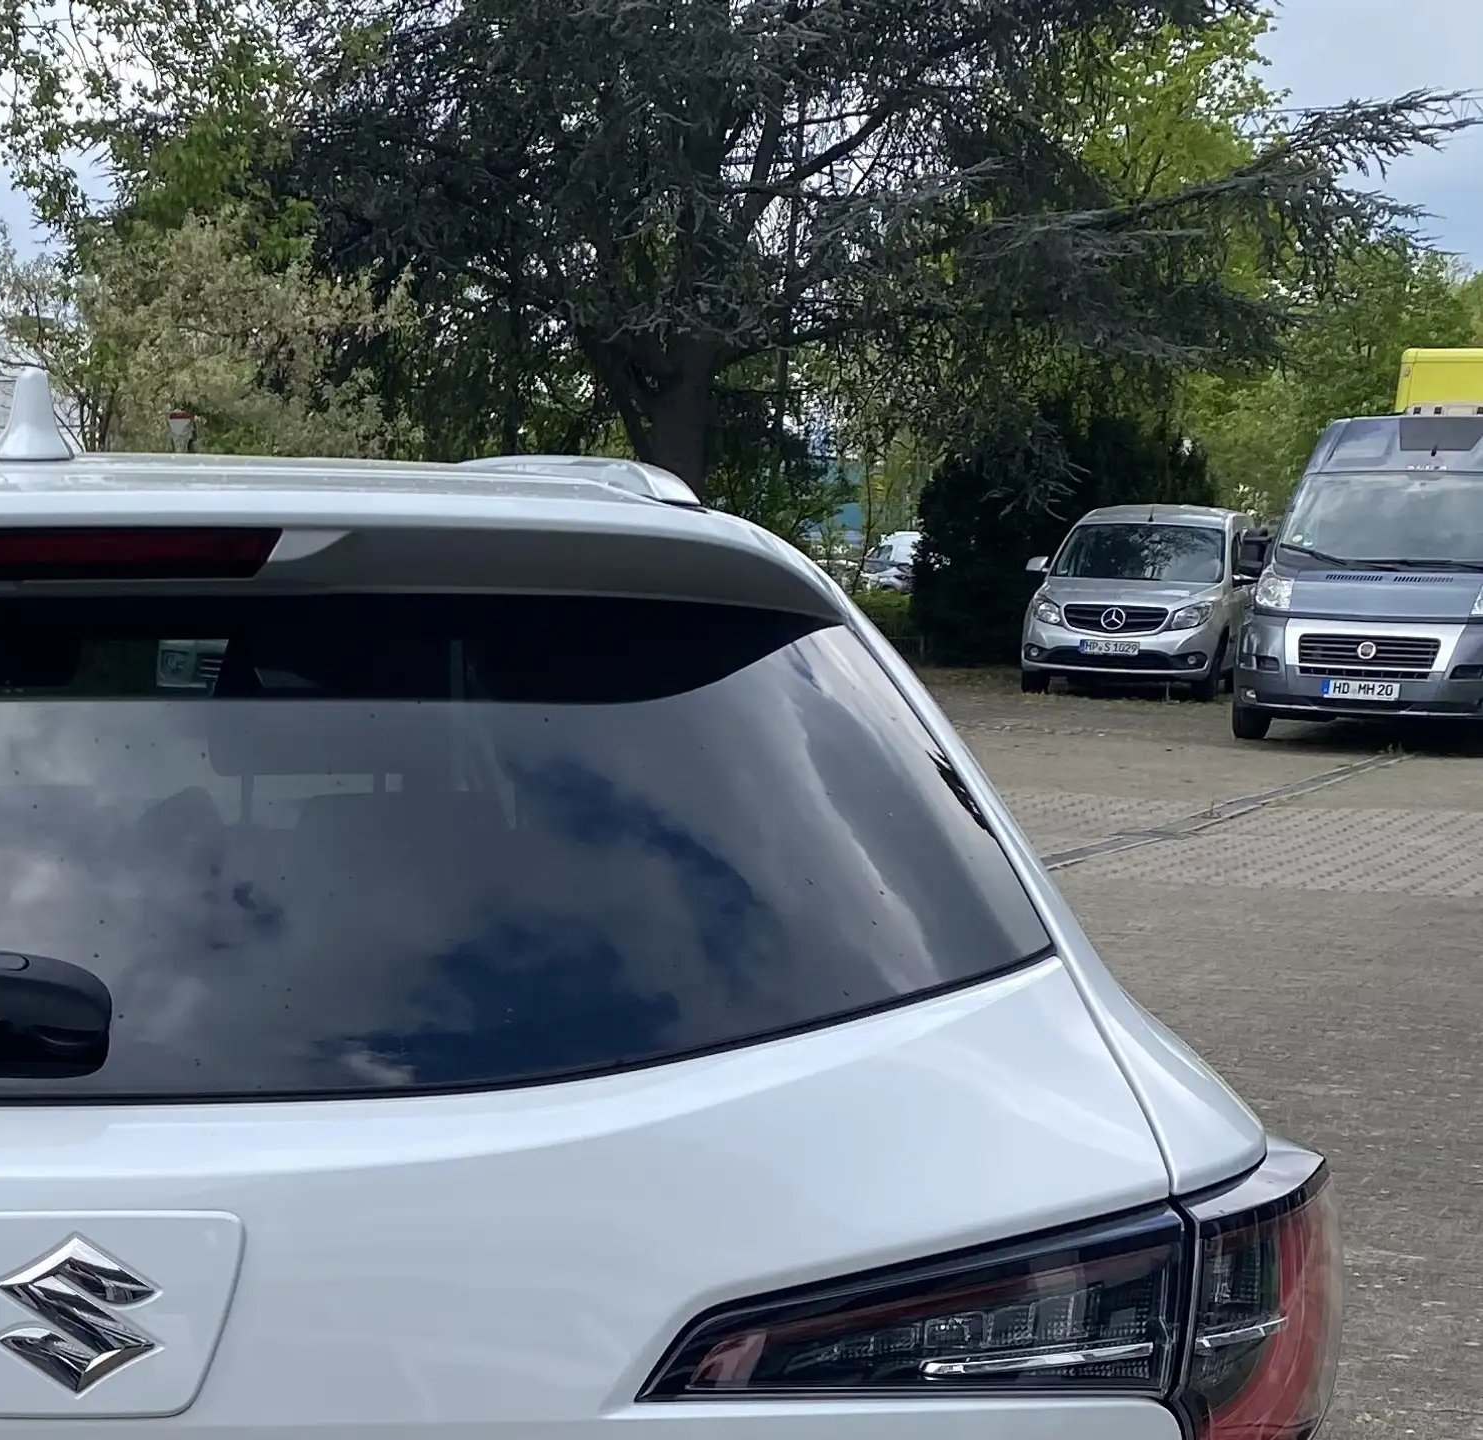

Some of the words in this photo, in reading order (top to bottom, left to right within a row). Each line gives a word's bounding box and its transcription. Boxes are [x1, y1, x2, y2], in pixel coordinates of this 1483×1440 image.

[1333, 682, 1350, 694] HD
[1357, 683, 1375, 695] MH
[1377, 684, 1394, 696] 20
